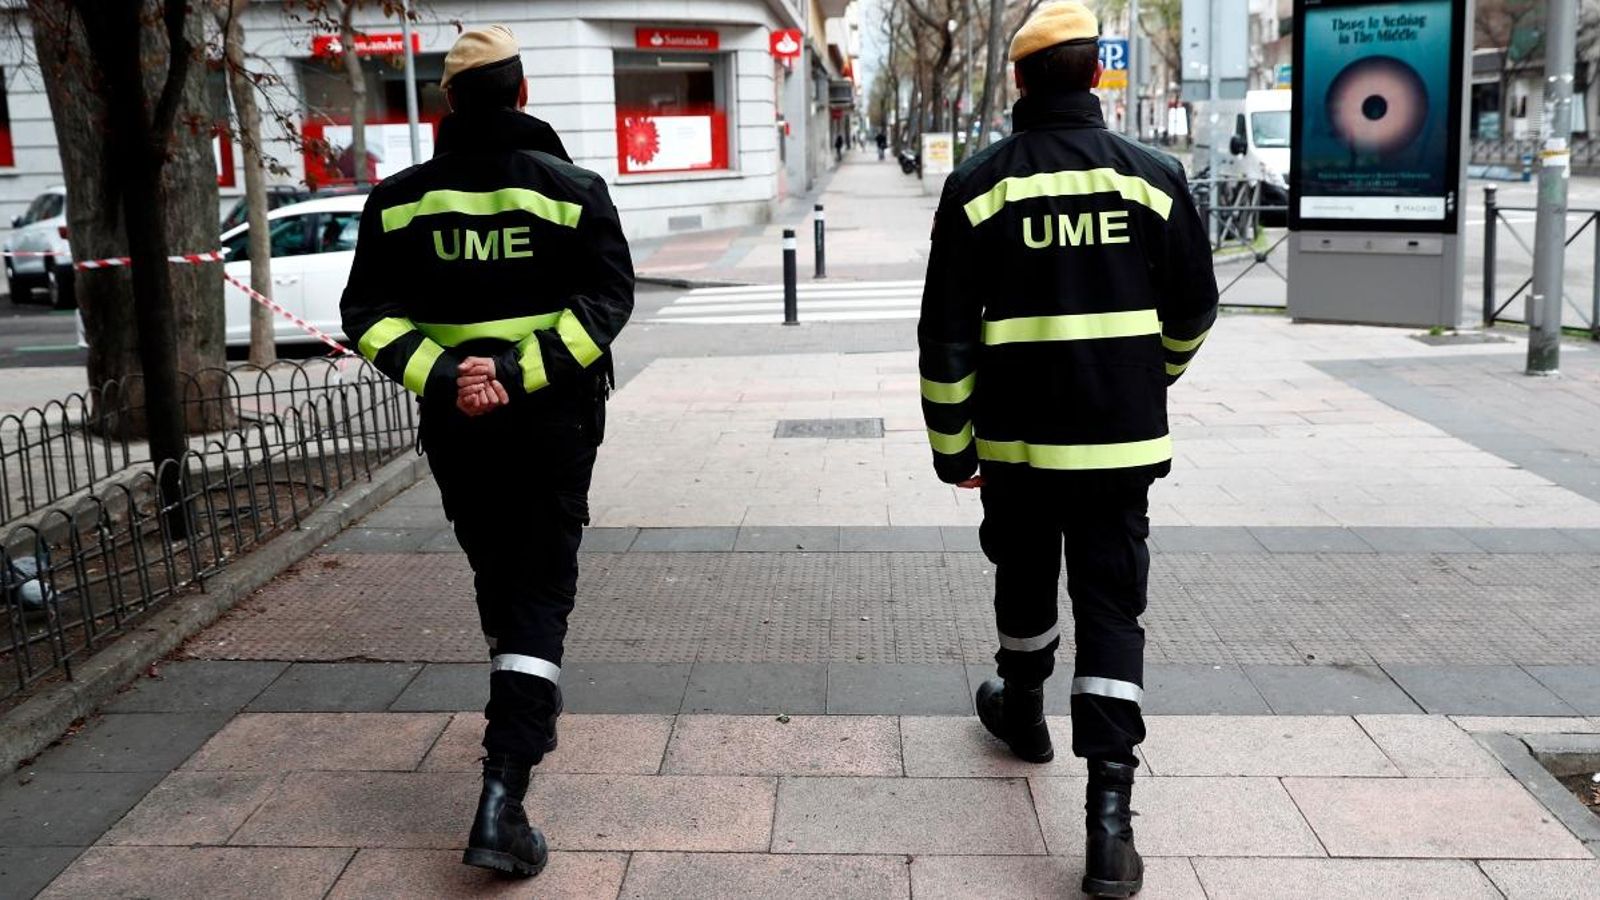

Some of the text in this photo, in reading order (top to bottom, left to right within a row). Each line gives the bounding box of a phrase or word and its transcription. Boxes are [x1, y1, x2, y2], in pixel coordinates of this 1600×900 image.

[1383, 13, 1427, 29] Nothing
[664, 32, 709, 46] Santander
[1353, 30, 1374, 43] The
[1377, 28, 1418, 42] Middle
[1022, 210, 1130, 249] UME
[432, 226, 534, 261] UME
